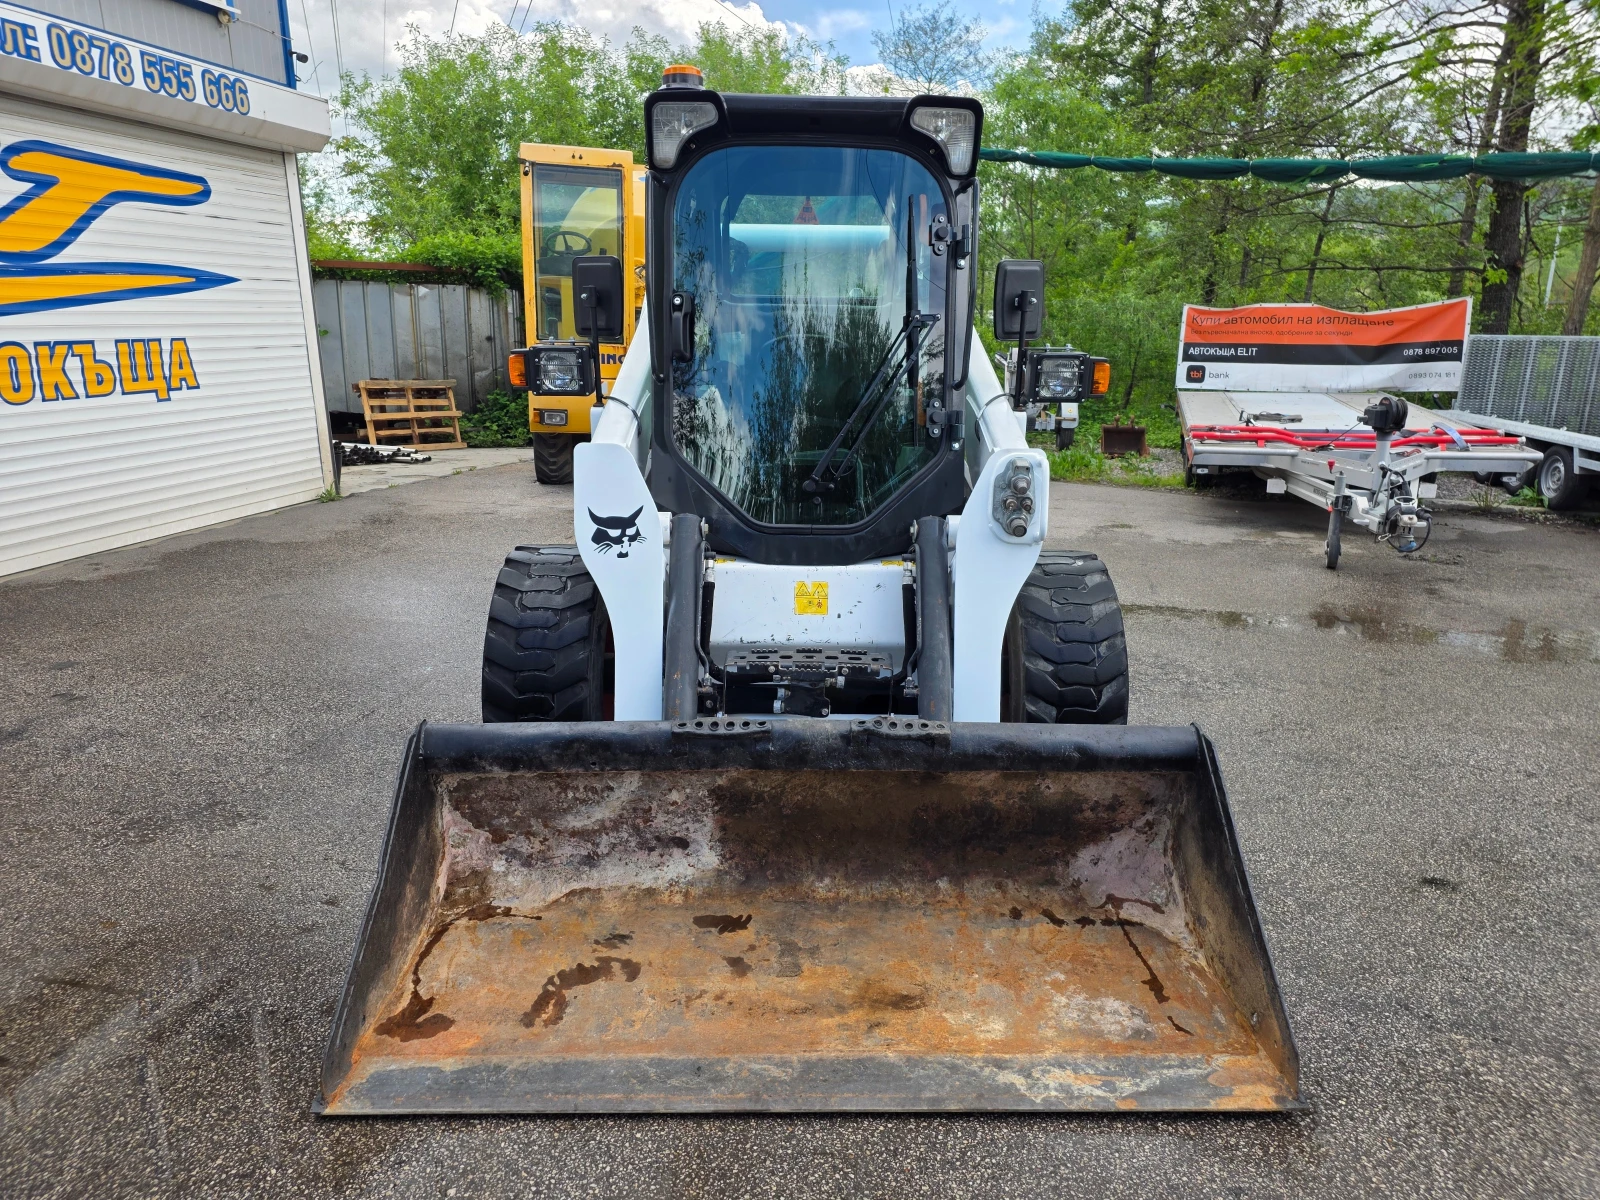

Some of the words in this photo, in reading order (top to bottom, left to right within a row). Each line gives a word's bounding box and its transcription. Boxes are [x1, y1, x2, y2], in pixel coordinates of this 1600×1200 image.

[46, 22, 135, 87] 0878
[139, 49, 197, 103] 555
[201, 68, 250, 116] 666
[1191, 314, 1221, 327] Купи
[1223, 314, 1293, 325] автомобил
[1296, 316, 1313, 325] на
[1316, 316, 1395, 327] изплащане
[1275, 329, 1314, 337] одобрение
[1188, 346, 1236, 357] АВТОКЪЩА
[1237, 347, 1258, 356] ELIT
[1403, 348, 1423, 356] 0878
[1424, 347, 1441, 355] 897
[1441, 346, 1458, 354] 005
[0, 337, 201, 407] ОКЪЩА
[1190, 370, 1203, 379] tbi
[1208, 371, 1230, 379] bank
[1408, 372, 1427, 380] 0893
[1428, 371, 1442, 379] 074
